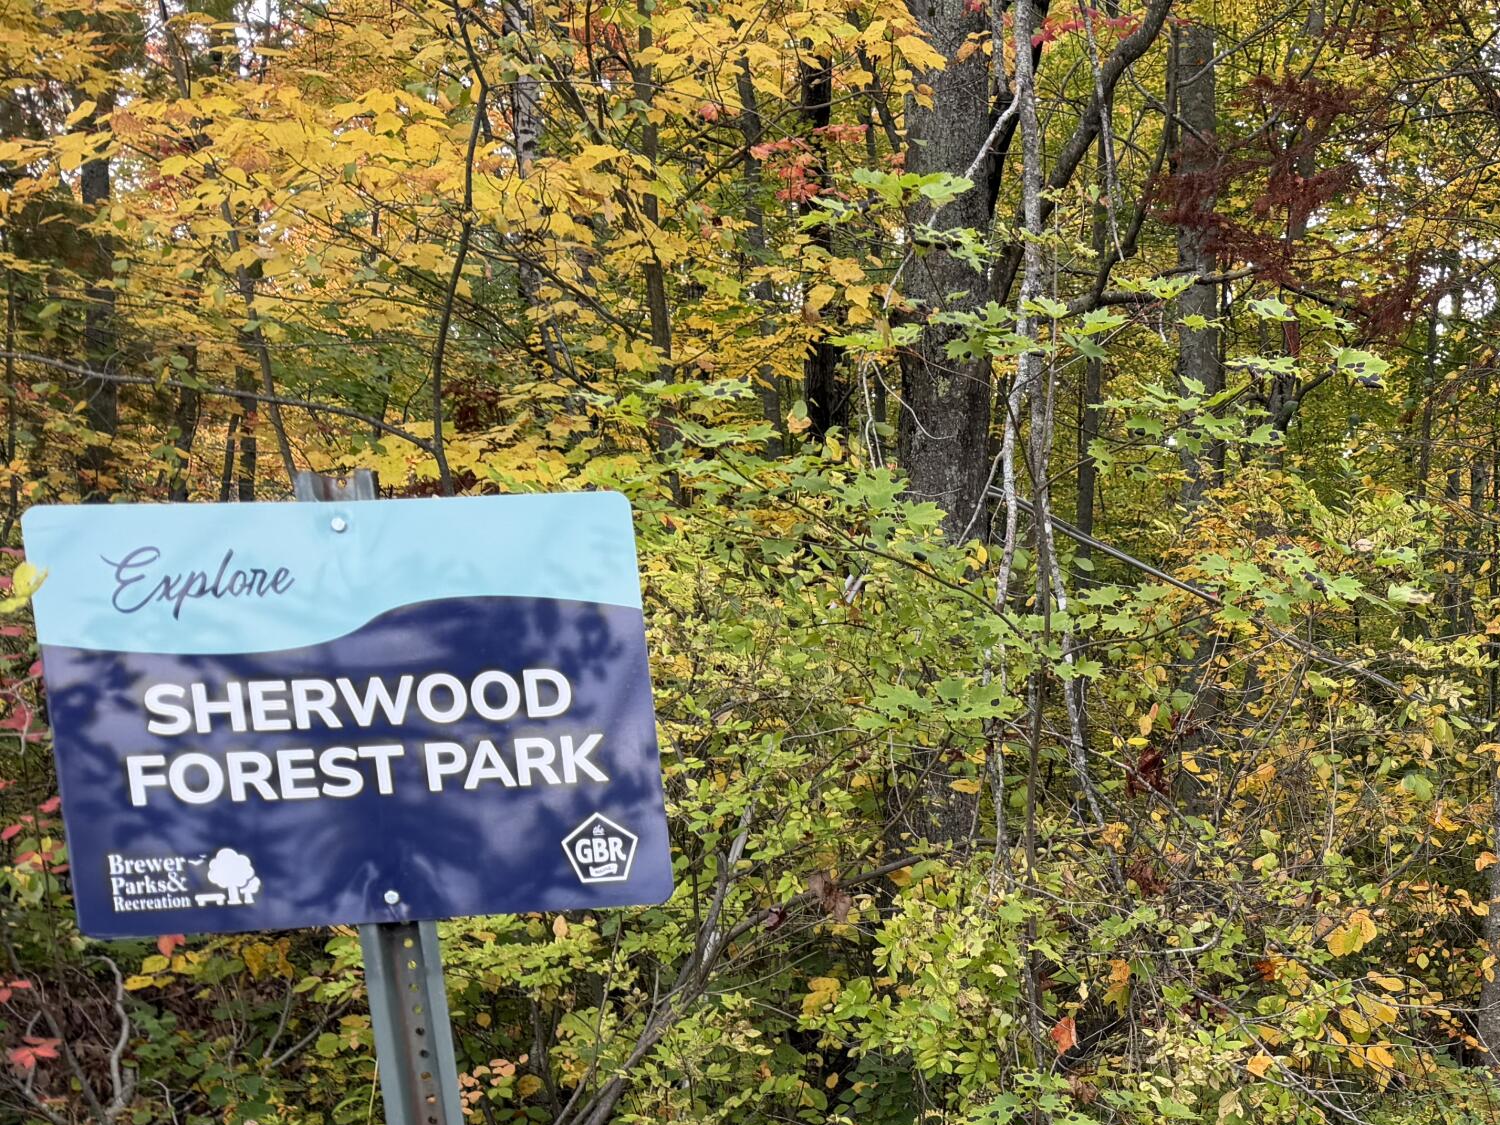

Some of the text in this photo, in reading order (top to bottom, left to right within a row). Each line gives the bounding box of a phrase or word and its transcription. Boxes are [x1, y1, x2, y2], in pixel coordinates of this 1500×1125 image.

[101, 546, 294, 620] Explore
[144, 668, 572, 735] SHERWOOD
[126, 734, 609, 806] FOREST PARK
[108, 854, 186, 875] Brewer
[575, 837, 627, 863] GBR
[114, 895, 192, 912] Recreation
